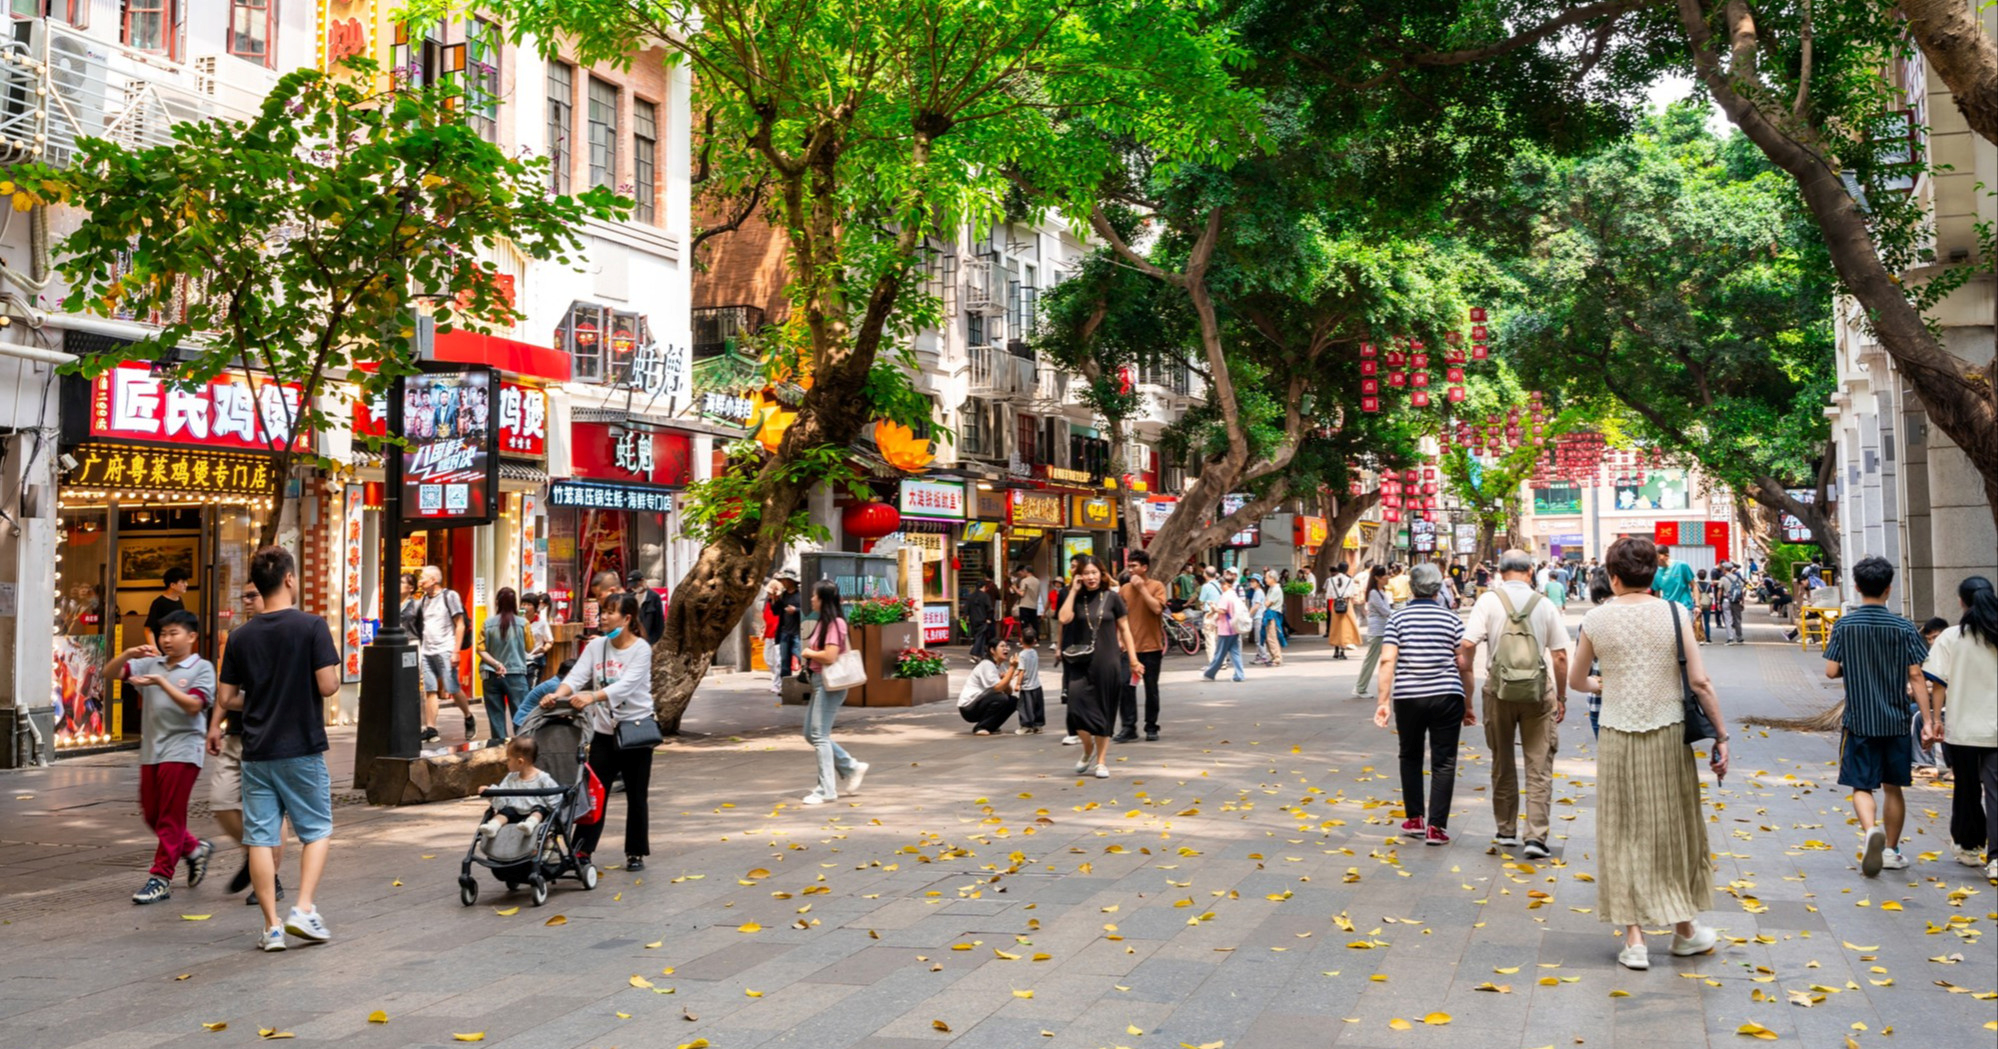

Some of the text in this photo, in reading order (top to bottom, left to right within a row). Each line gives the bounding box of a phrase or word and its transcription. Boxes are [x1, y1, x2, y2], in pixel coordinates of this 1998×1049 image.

[110, 367, 299, 444] 匠氏鸡煲
[80, 453, 267, 489] 广府粤菜鸡煲专门店
